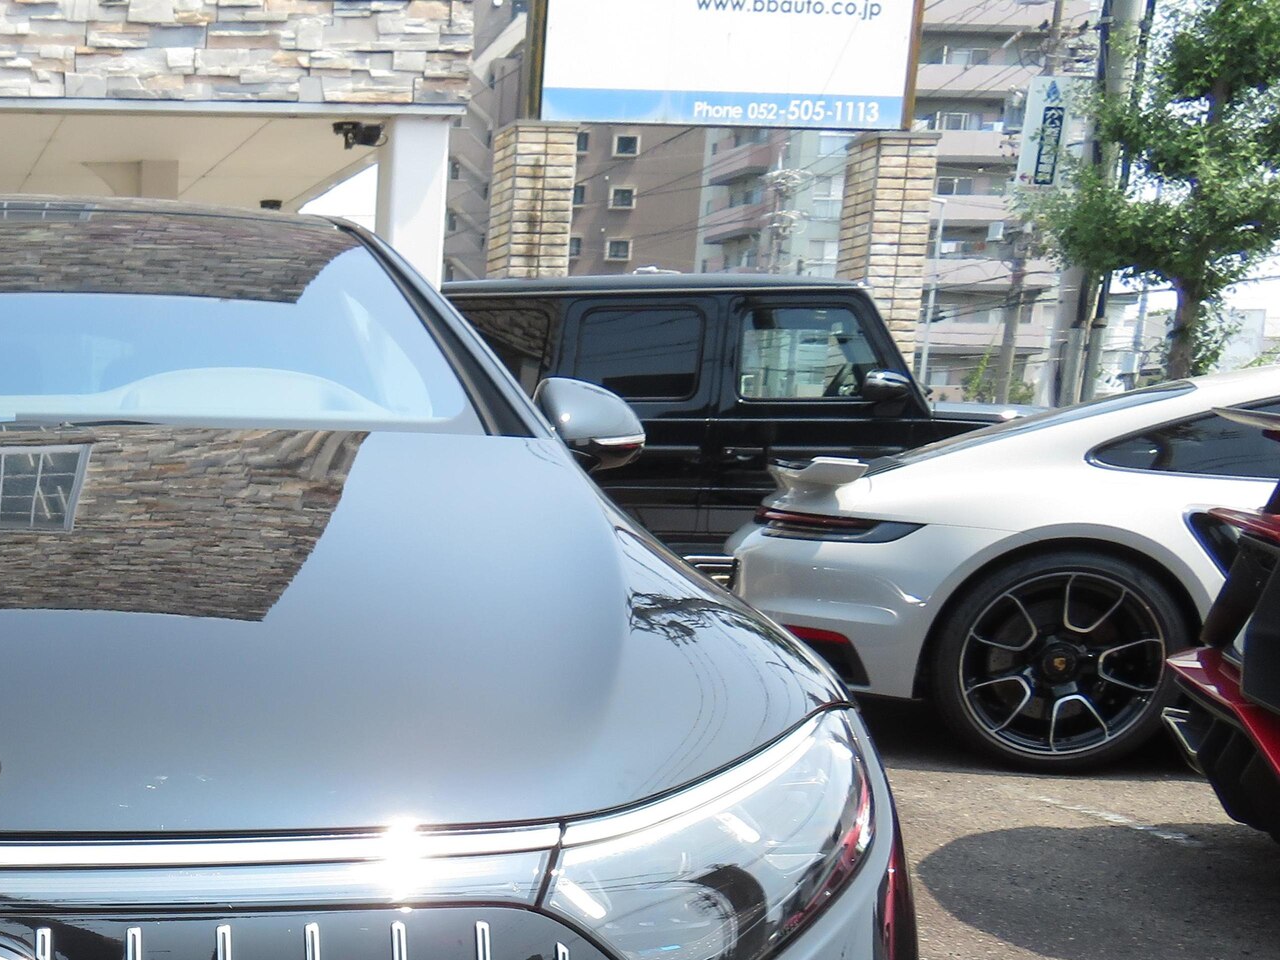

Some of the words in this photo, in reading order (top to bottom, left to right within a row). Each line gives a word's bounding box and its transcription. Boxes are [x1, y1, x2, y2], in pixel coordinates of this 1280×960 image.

[696, 0, 882, 20] www.bbauto.co.jp
[693, 101, 743, 119] Phone
[747, 99, 880, 123] 052-505-1113
